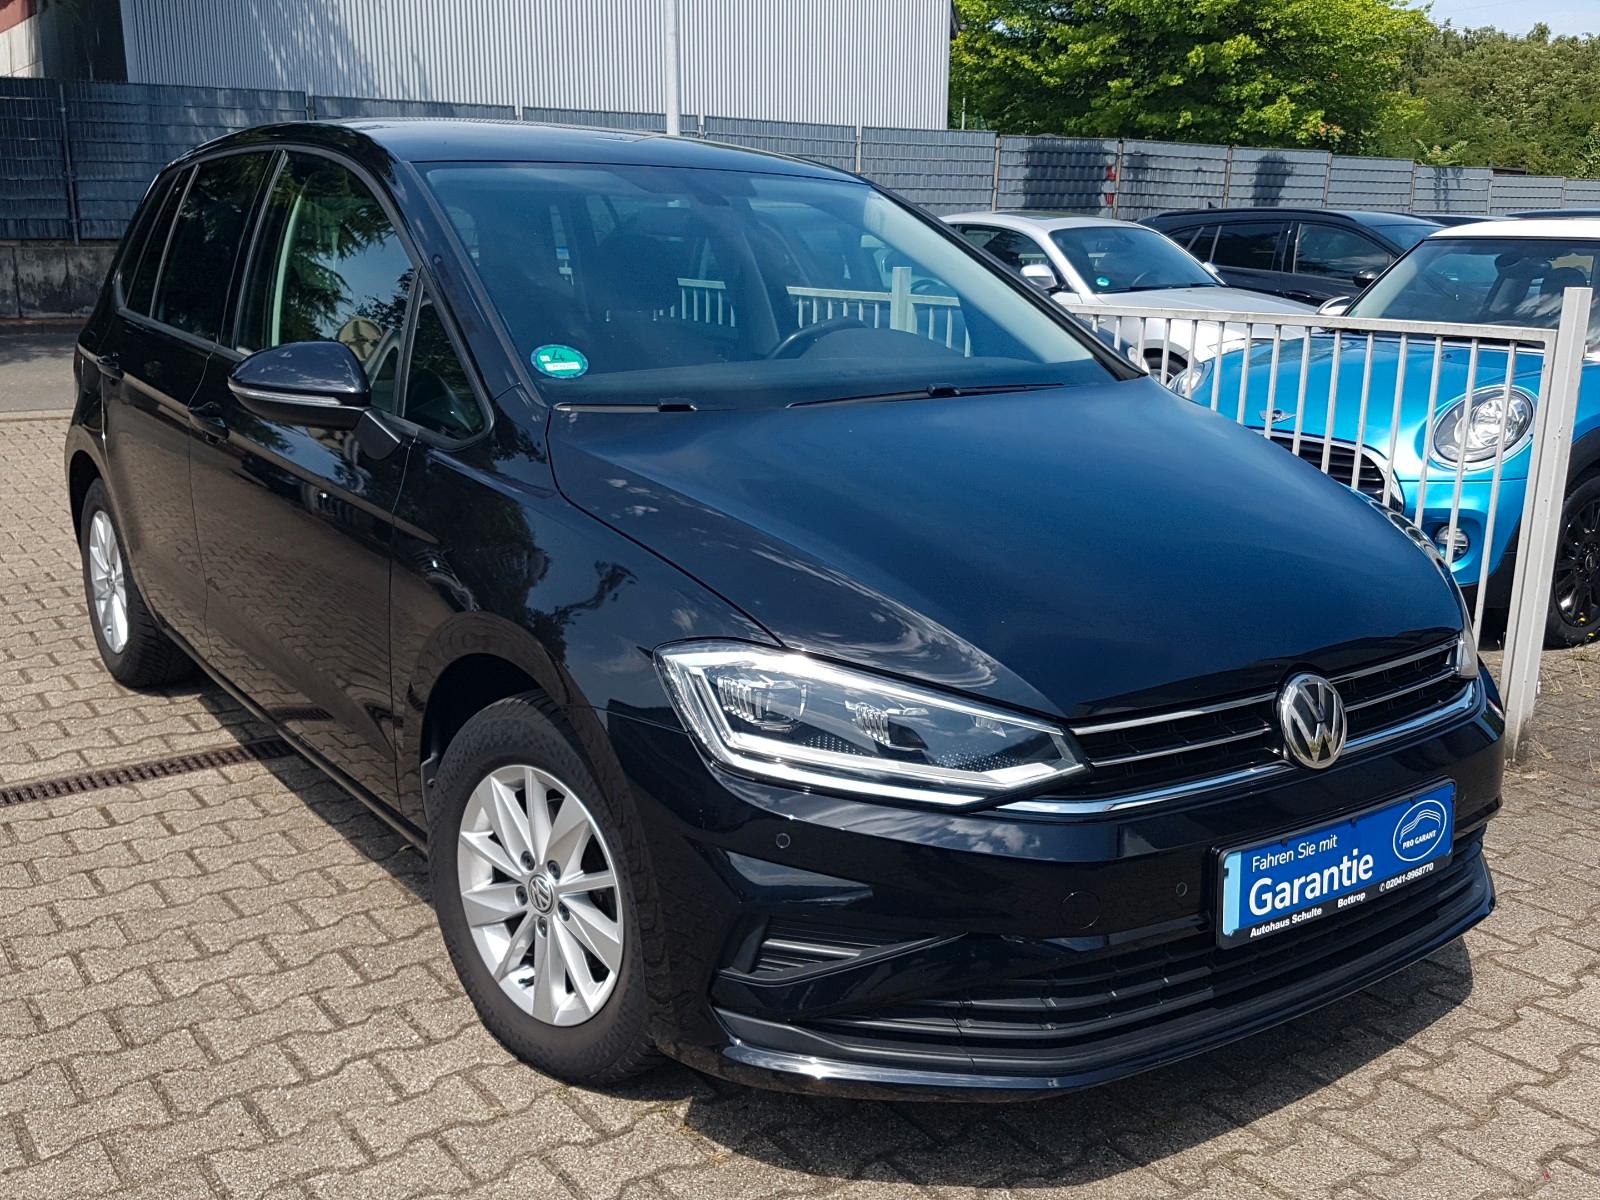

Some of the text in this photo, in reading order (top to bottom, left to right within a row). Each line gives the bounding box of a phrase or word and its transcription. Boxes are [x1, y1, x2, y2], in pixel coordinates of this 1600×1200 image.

[552, 349, 565, 361] 4
[1281, 673, 1347, 769] VW
[1252, 834, 1338, 873] Fahren Sie mit
[1402, 829, 1437, 850] PRO GARANT
[1249, 848, 1374, 916] Garantie
[1250, 918, 1290, 938] Autohaus
[1292, 907, 1323, 925] Schulte
[1337, 892, 1366, 908] Bottrop
